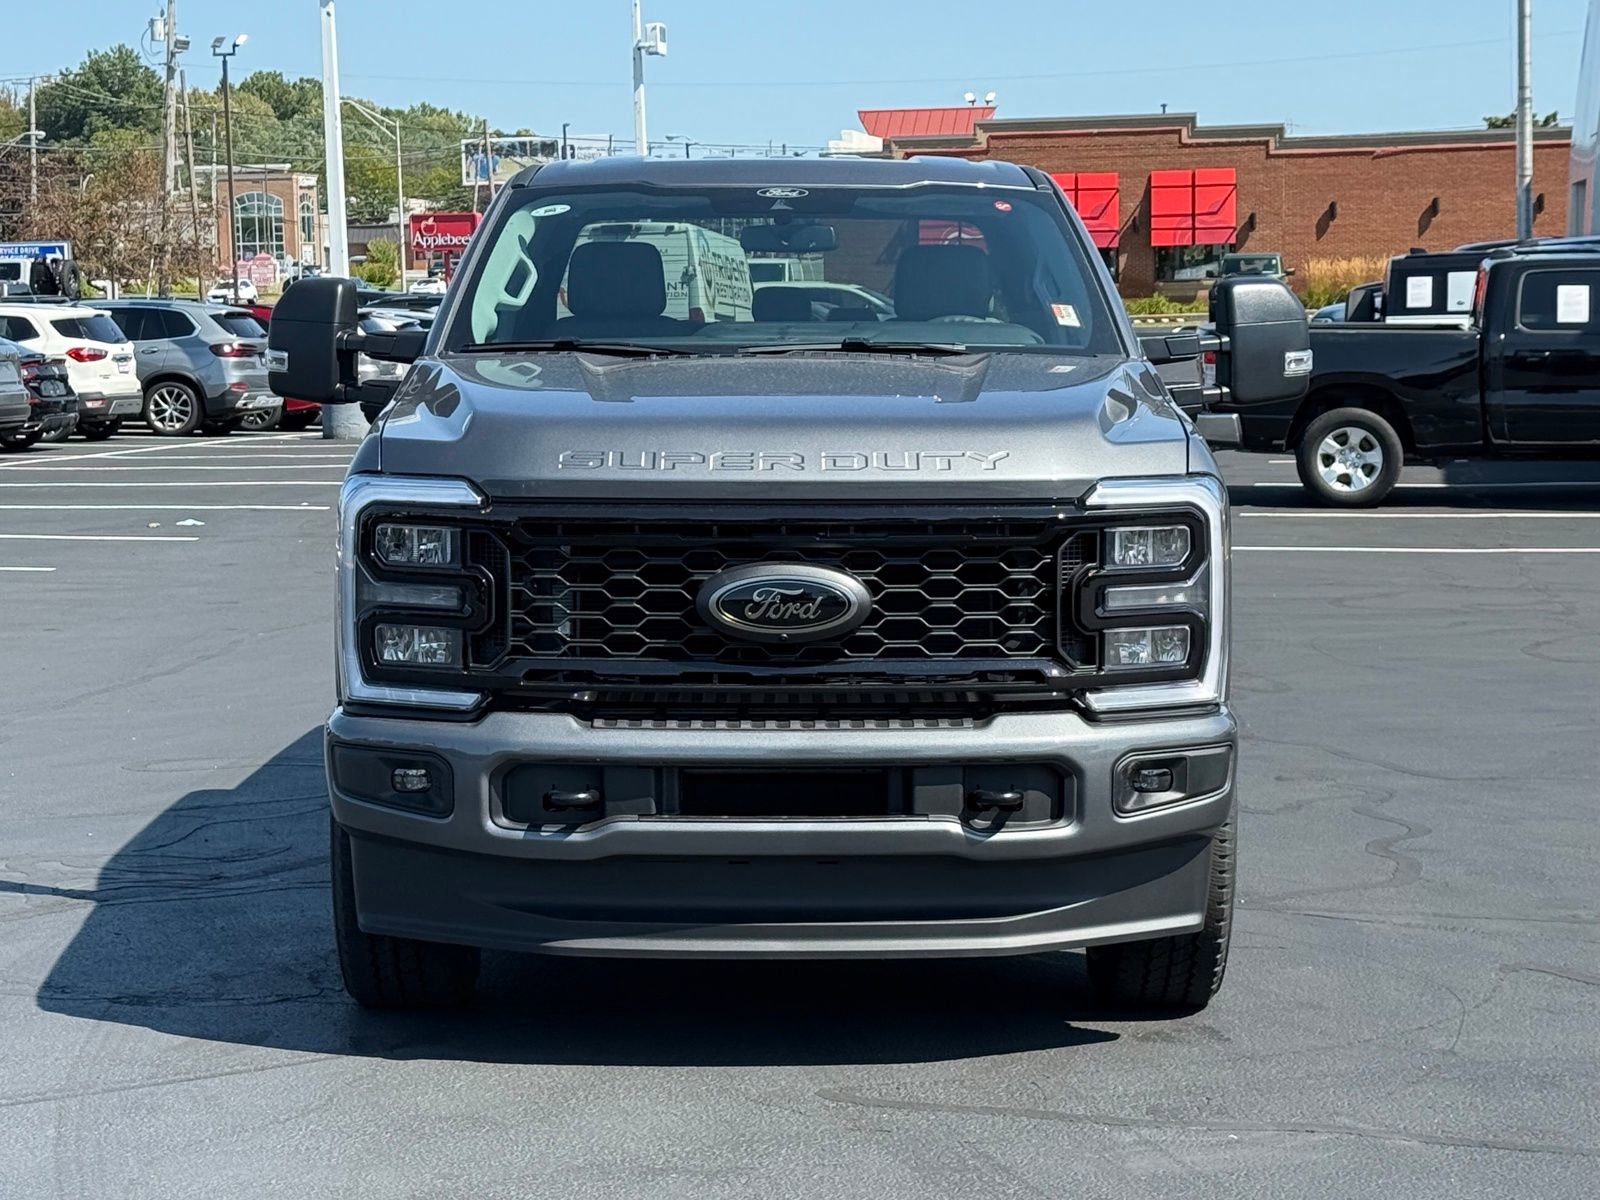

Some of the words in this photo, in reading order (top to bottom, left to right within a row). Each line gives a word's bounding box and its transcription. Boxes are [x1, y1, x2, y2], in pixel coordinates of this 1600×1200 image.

[20, 247, 40, 255] DRIVE
[558, 450, 805, 471] SUPER
[821, 450, 1010, 471] DUTY
[744, 587, 824, 620] Ford
